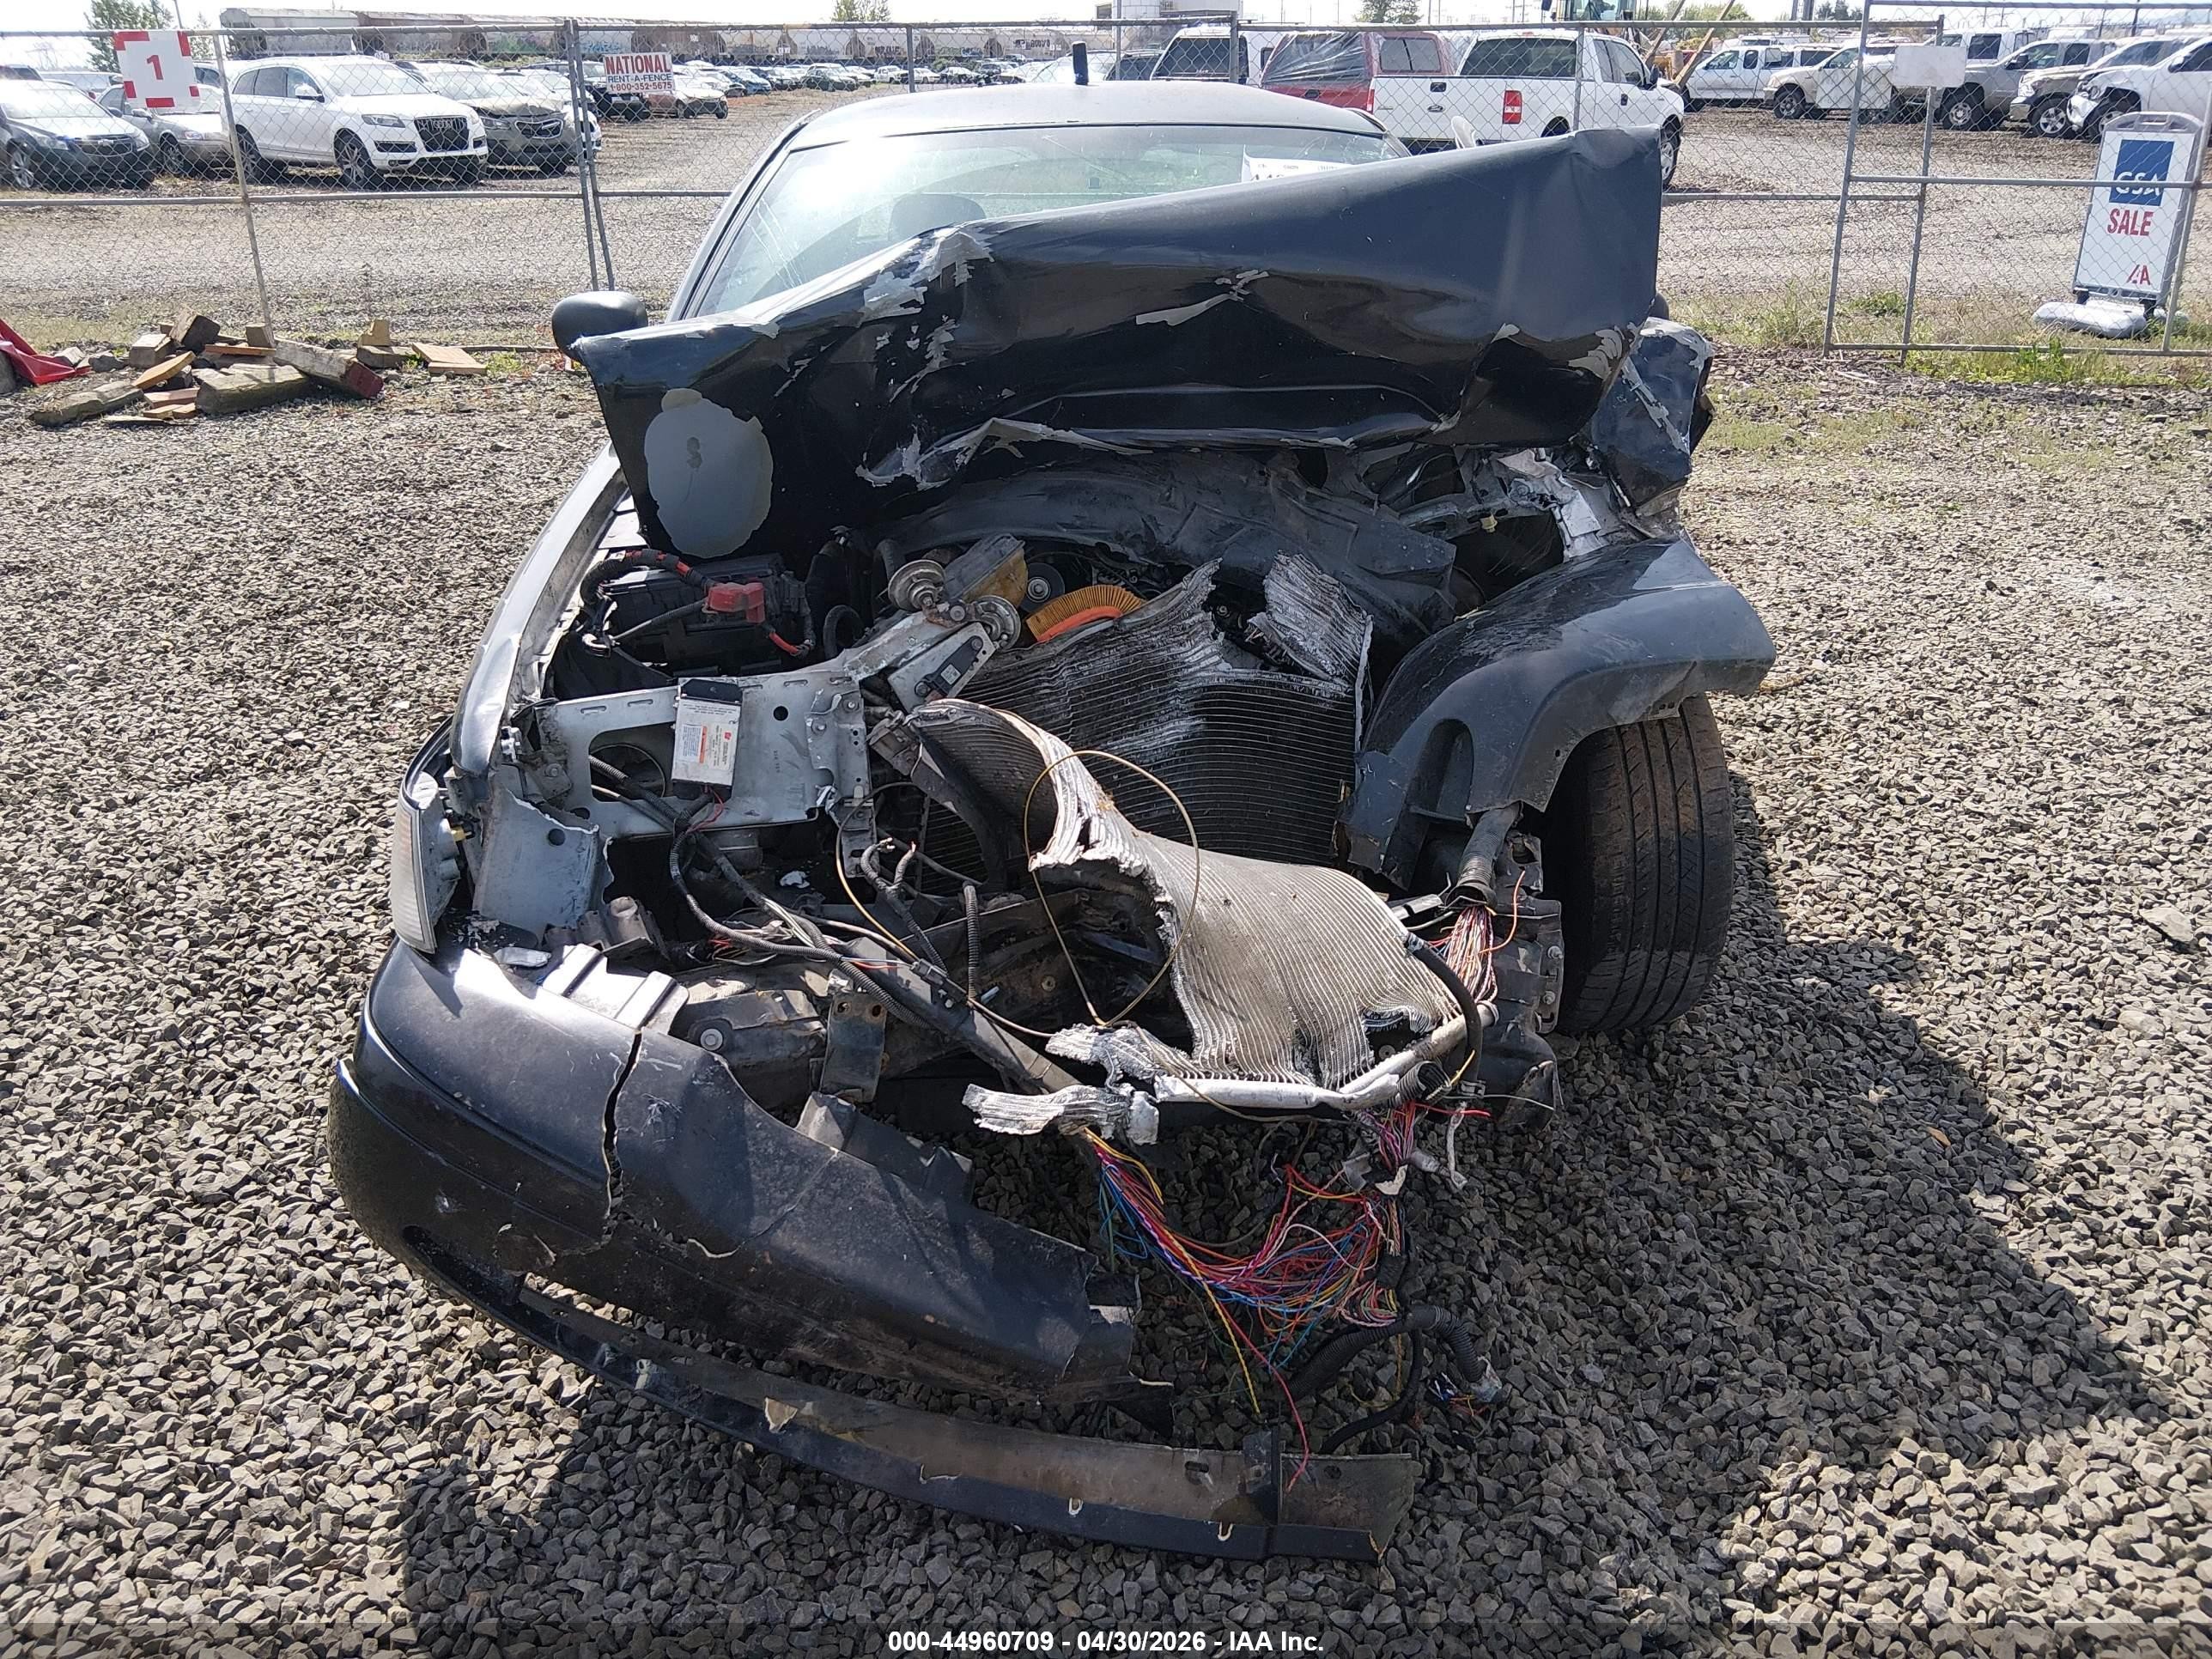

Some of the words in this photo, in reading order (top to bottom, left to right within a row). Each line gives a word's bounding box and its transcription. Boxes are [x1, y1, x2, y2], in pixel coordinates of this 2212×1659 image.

[147, 55, 164, 80] 1
[605, 55, 671, 75] NATIONAL
[608, 74, 672, 83] RENT-A-FENCE
[611, 82, 672, 91] 1-800-352-5675
[2116, 171, 2162, 196] GSA
[2107, 208, 2154, 236] SALE
